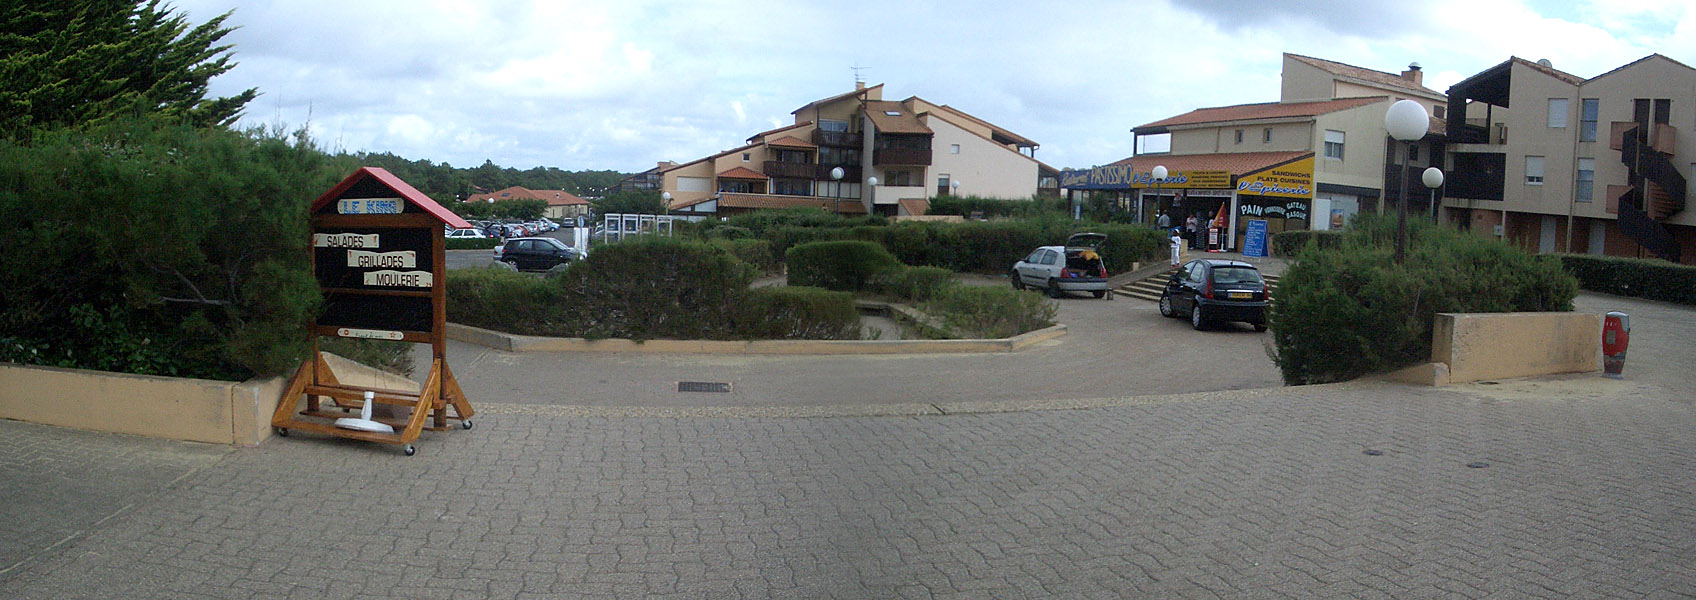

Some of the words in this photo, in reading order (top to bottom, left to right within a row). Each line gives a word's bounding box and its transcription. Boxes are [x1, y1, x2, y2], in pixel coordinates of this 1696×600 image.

[1091, 165, 1132, 185] PASTISSIMO
[1272, 170, 1311, 178] SANDWICHS
[343, 201, 360, 214] LE
[366, 200, 397, 214] KING
[1241, 204, 1263, 216] PAIN
[1286, 202, 1306, 211] GATEAU
[1286, 210, 1307, 220] BASQUE
[327, 236, 364, 248] SALADES
[358, 256, 404, 267] GRILLADES
[376, 274, 419, 287] MOULERIE
